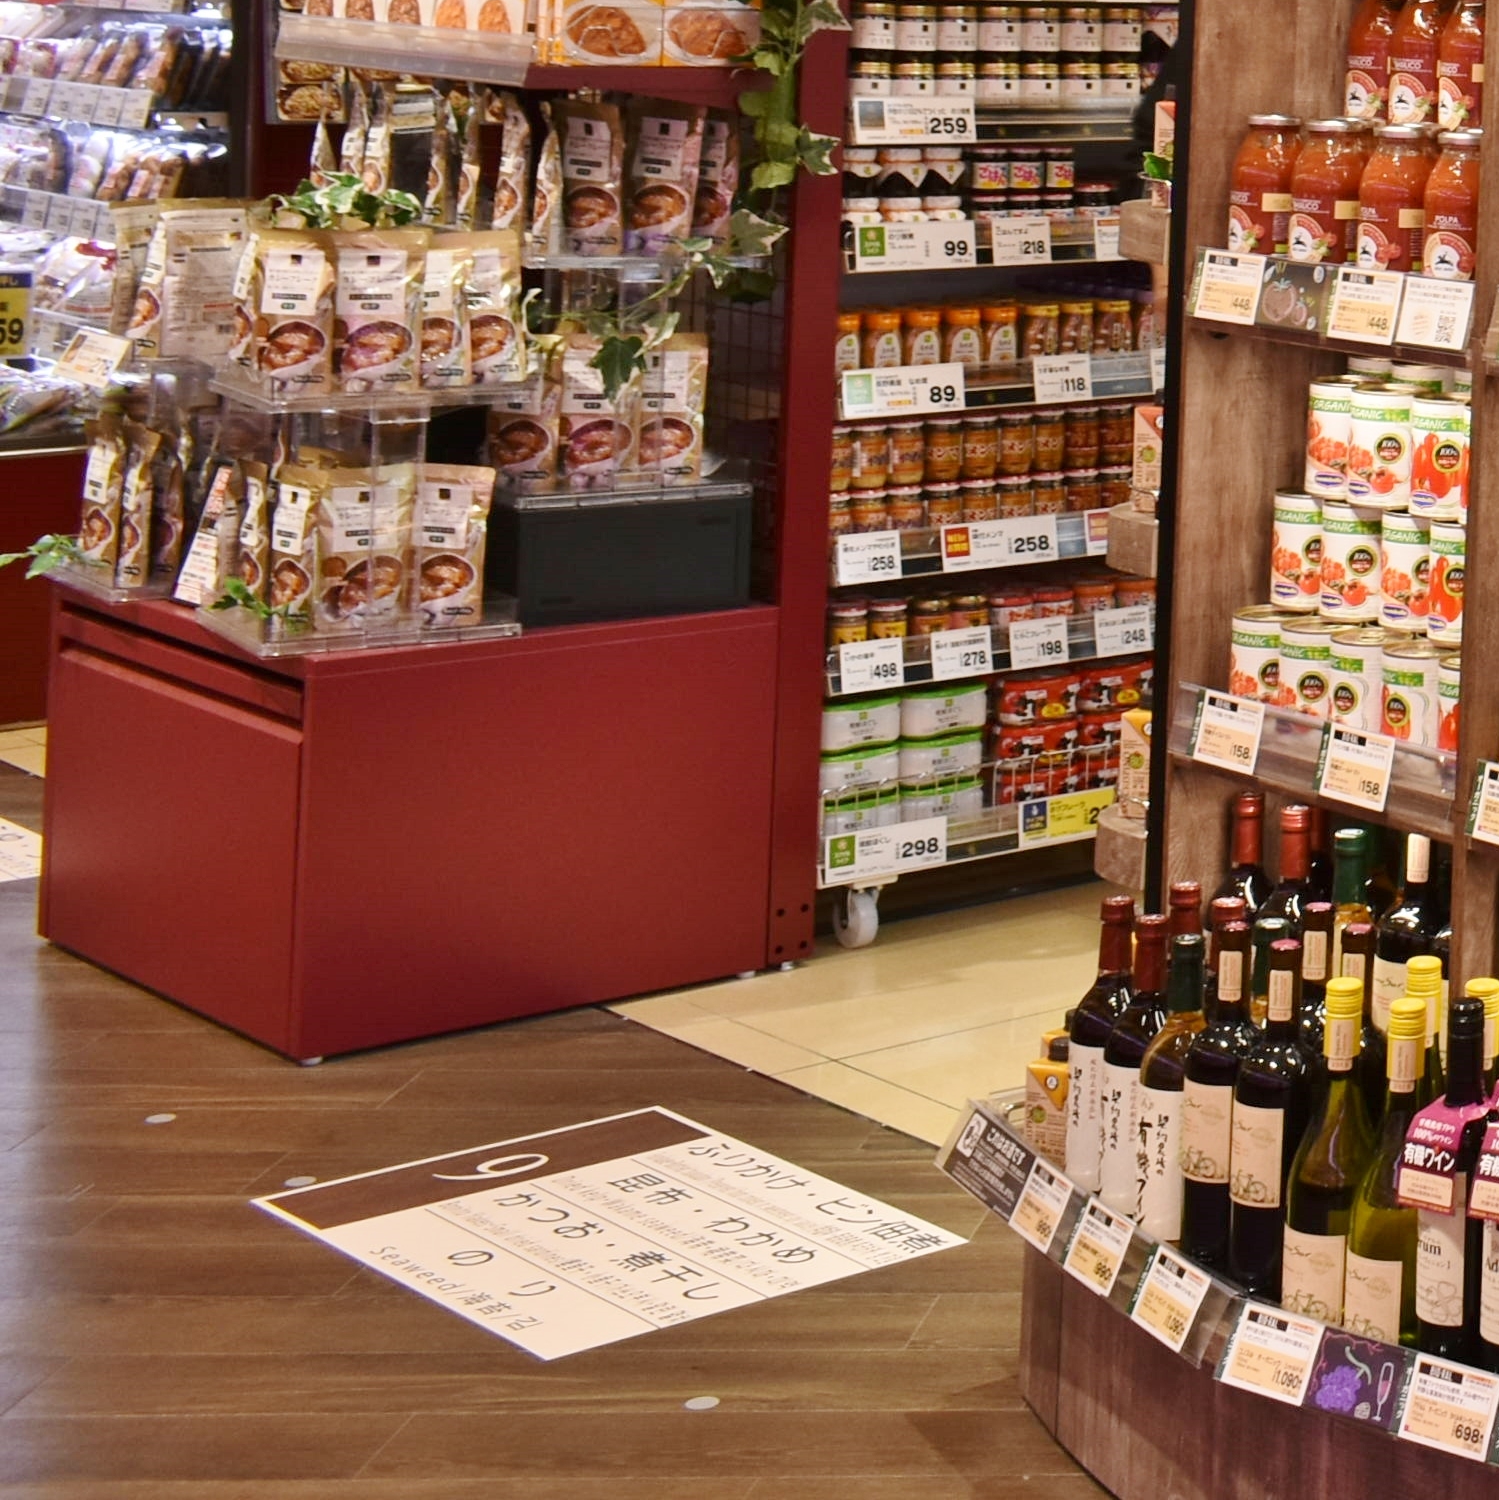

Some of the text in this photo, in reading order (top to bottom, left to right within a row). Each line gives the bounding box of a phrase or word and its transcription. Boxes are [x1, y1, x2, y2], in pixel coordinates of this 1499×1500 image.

[929, 116, 969, 135] 259
[943, 240, 969, 257] 99
[1022, 240, 1046, 255] 218
[929, 384, 956, 403] 89
[1063, 376, 1086, 392] 118
[1013, 535, 1050, 554] 258
[871, 556, 895, 572] 258
[1123, 628, 1147, 644] 248
[1040, 641, 1064, 657] 198
[963, 652, 986, 667] 278
[873, 663, 898, 679] 498
[901, 837, 939, 858] 298
[431, 1152, 550, 1182] 9
[1403, 1143, 1456, 1173] 有機ワイン
[688, 1142, 950, 1255] ふりかけ・ビン佃煮
[606, 1172, 816, 1265] 昆布・わかめ
[492, 1191, 721, 1302] かつお・煮干し
